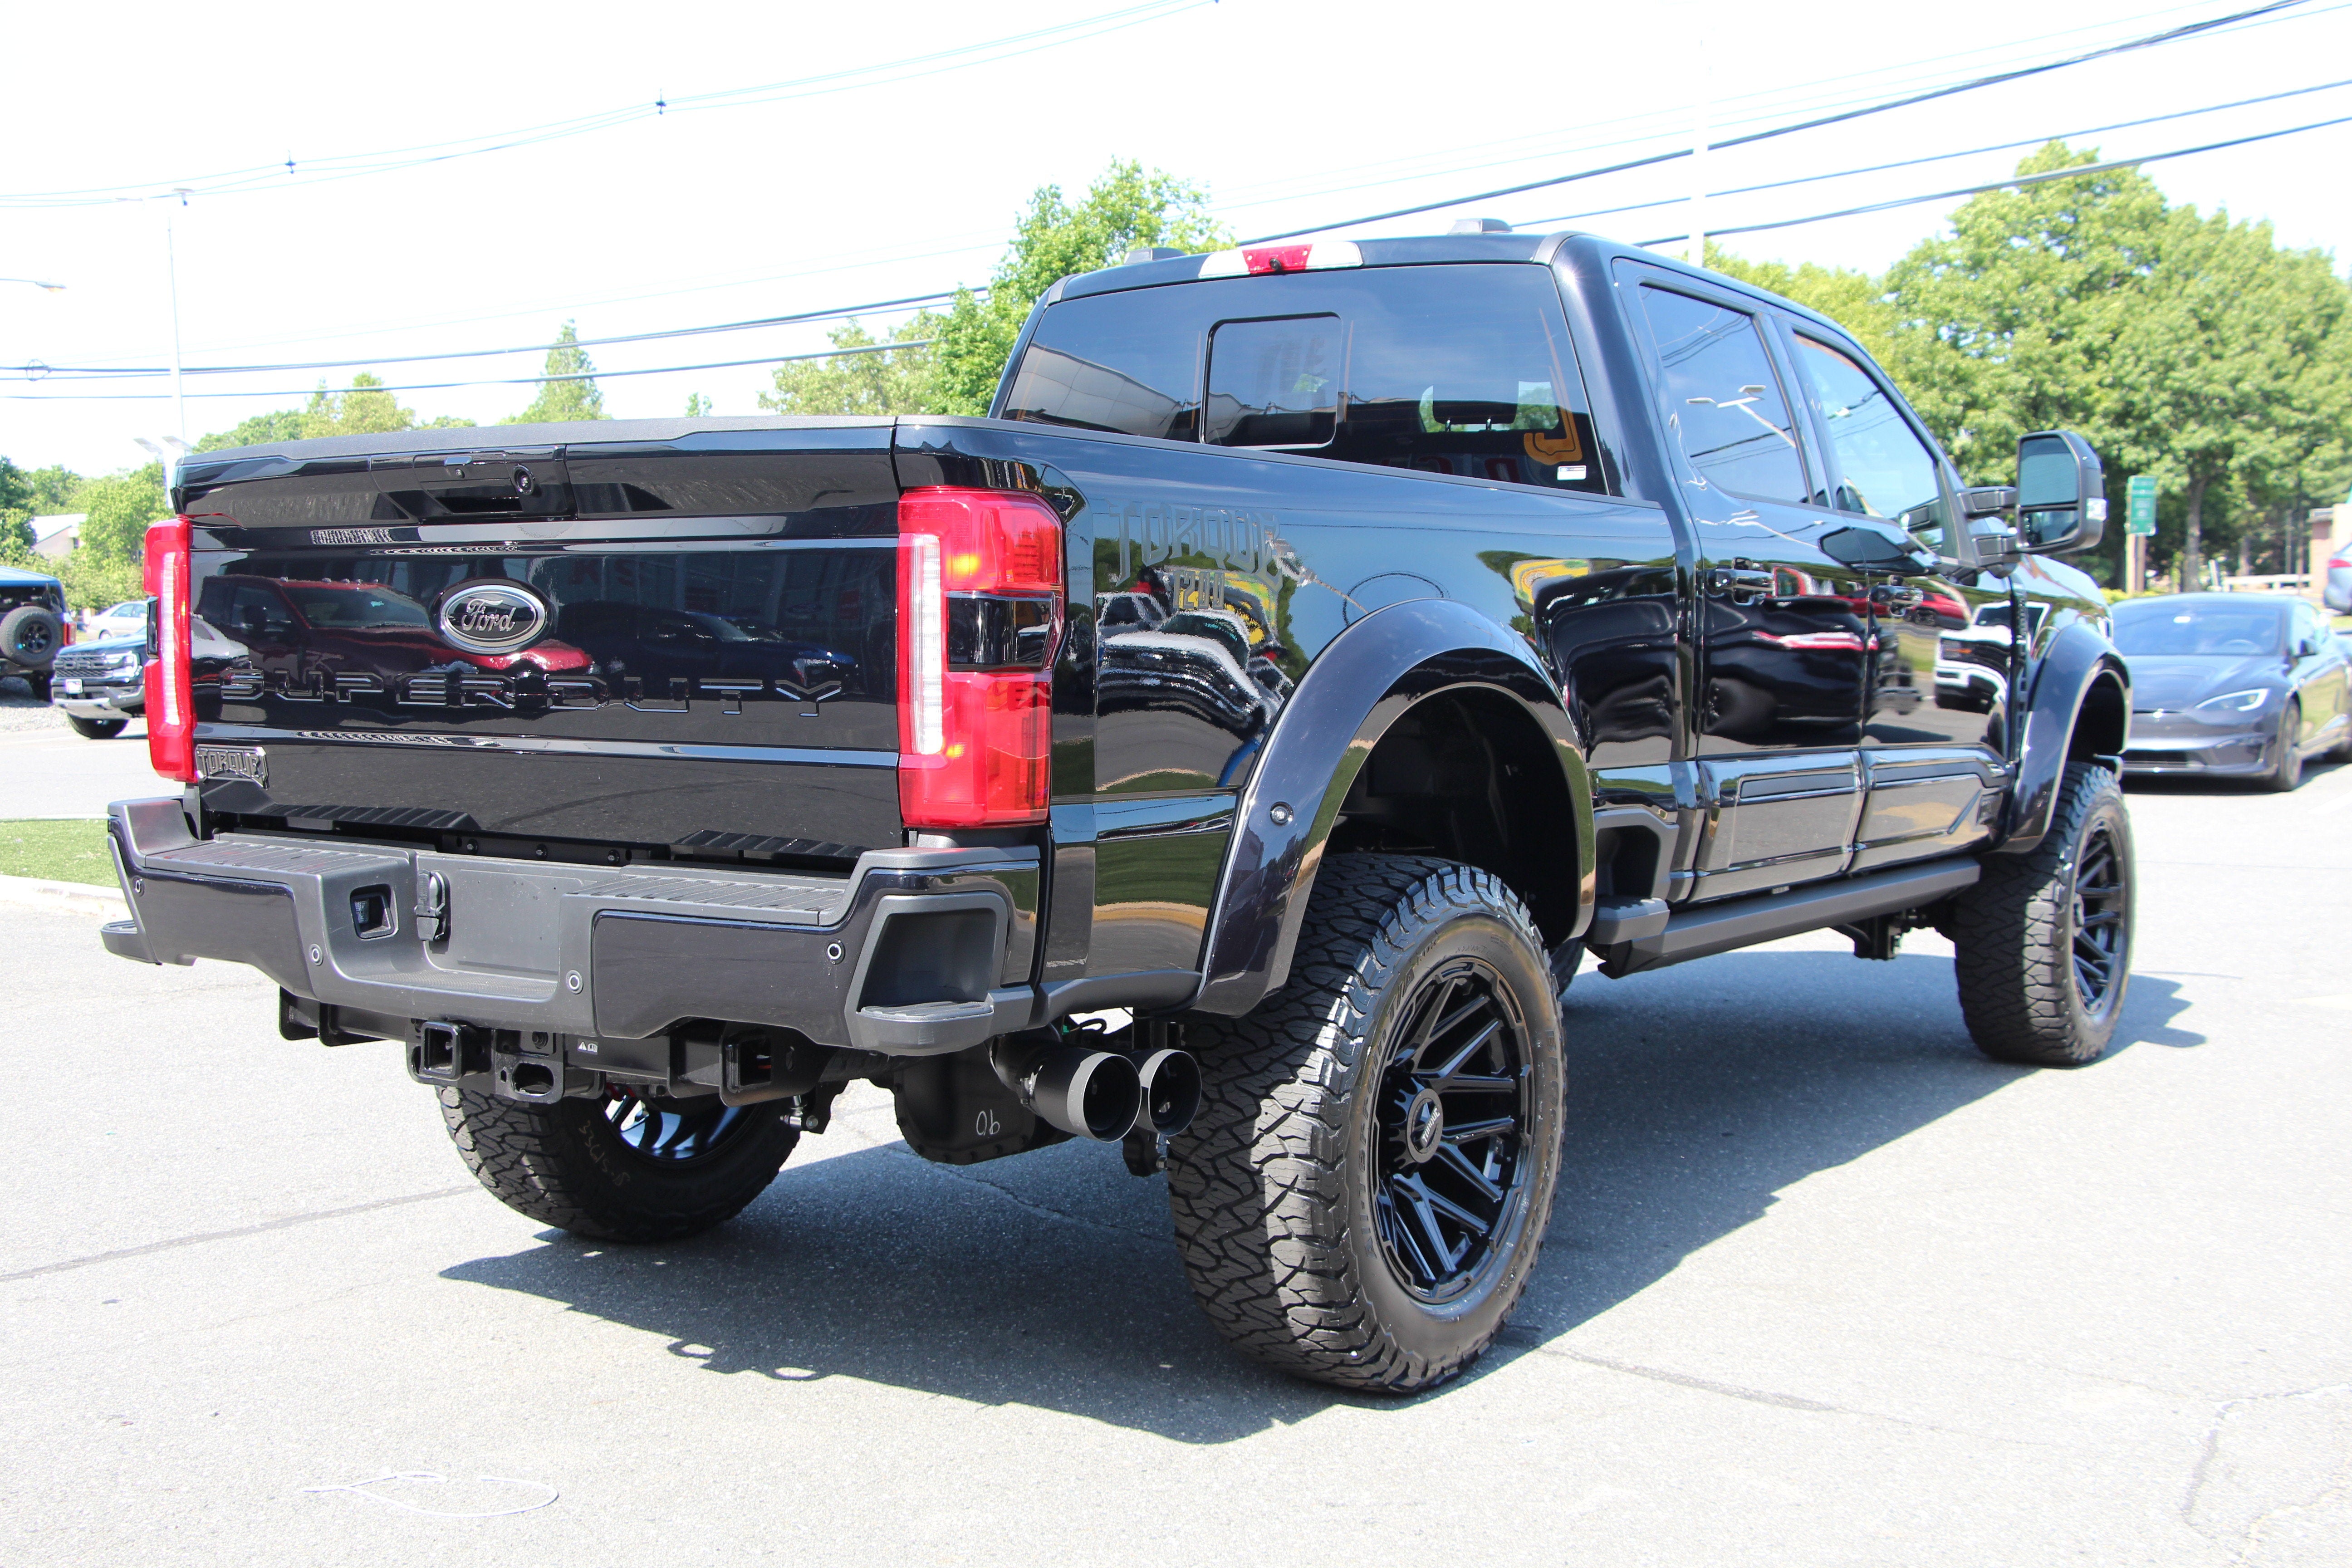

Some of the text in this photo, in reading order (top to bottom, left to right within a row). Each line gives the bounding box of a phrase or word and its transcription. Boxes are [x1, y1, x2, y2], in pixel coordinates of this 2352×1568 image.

[1105, 497, 1284, 595] TORQUE
[461, 598, 517, 632] Ford
[220, 668, 842, 718] SUPER DUTY
[196, 749, 264, 788] TORQUE
